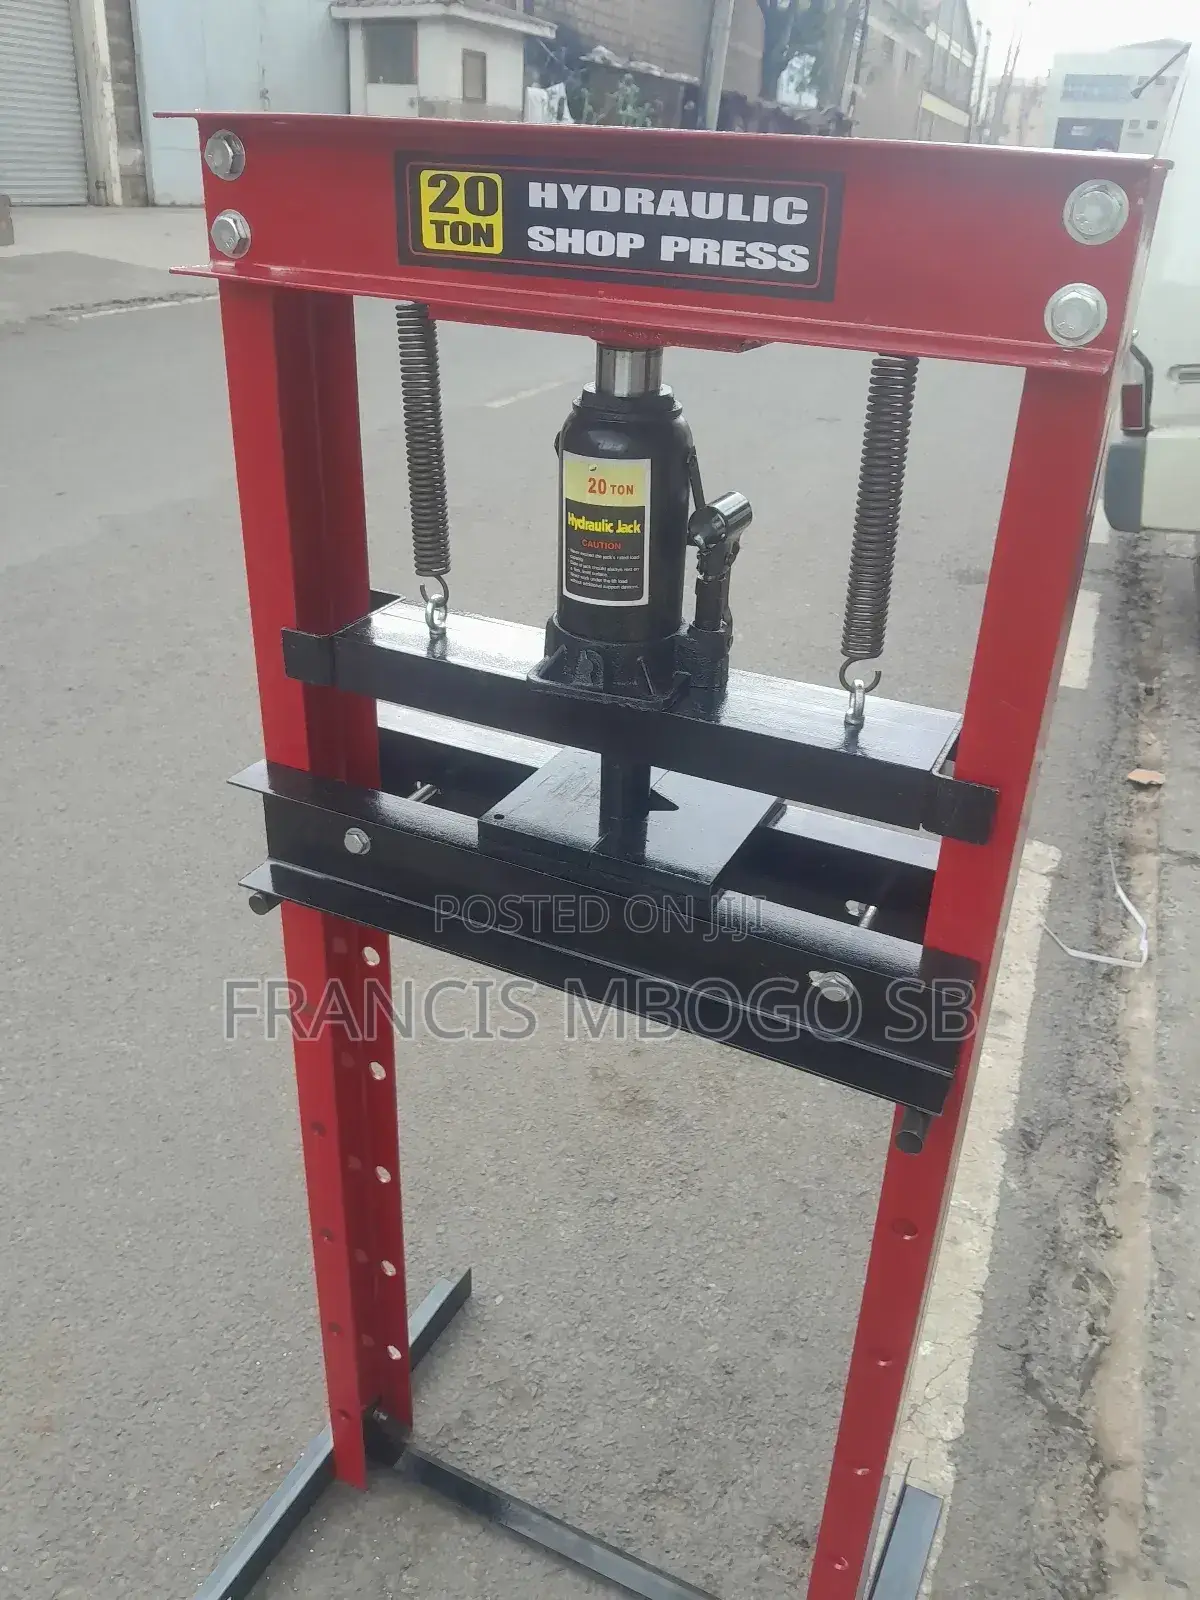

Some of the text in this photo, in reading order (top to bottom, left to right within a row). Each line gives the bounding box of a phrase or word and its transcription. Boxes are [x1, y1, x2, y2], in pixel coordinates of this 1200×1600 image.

[427, 173, 500, 217] 20
[528, 181, 809, 225] HYDRAULIC
[430, 219, 495, 248] TON
[527, 225, 810, 273] SHOP PRESS
[588, 478, 634, 495] 20 TON
[568, 512, 641, 533] Hydraulic Jack
[582, 539, 621, 550] CAUTION
